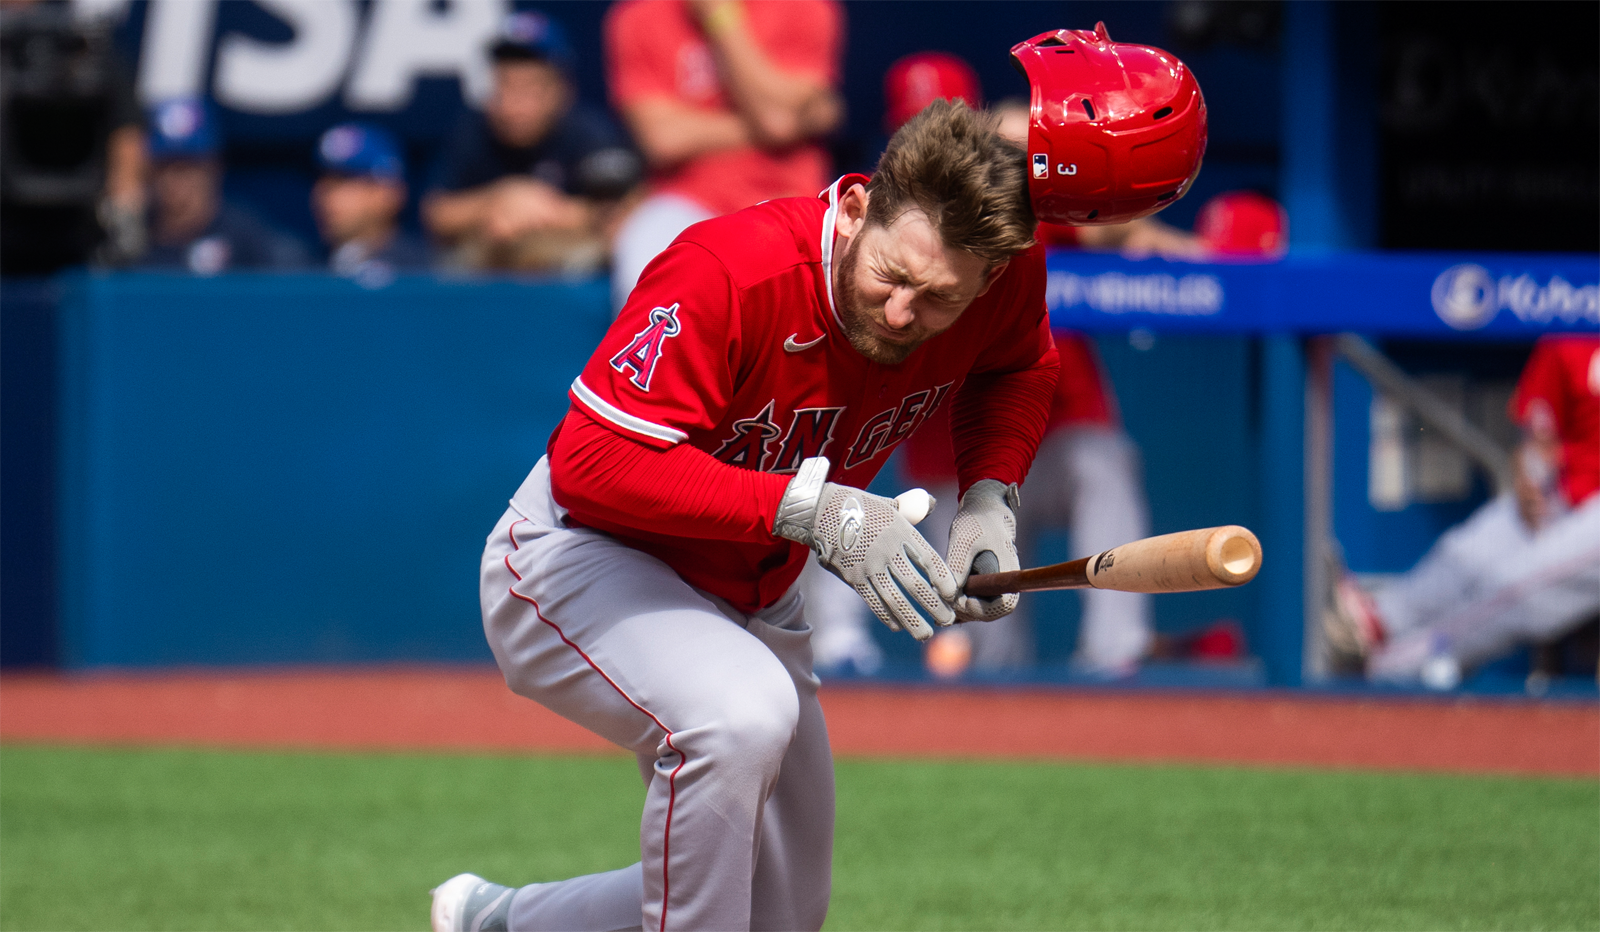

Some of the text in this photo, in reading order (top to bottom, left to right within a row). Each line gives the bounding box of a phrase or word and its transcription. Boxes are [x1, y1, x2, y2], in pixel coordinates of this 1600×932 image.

[76, 0, 508, 114] ISA
[1056, 162, 1078, 176] 3
[608, 302, 681, 392] A
